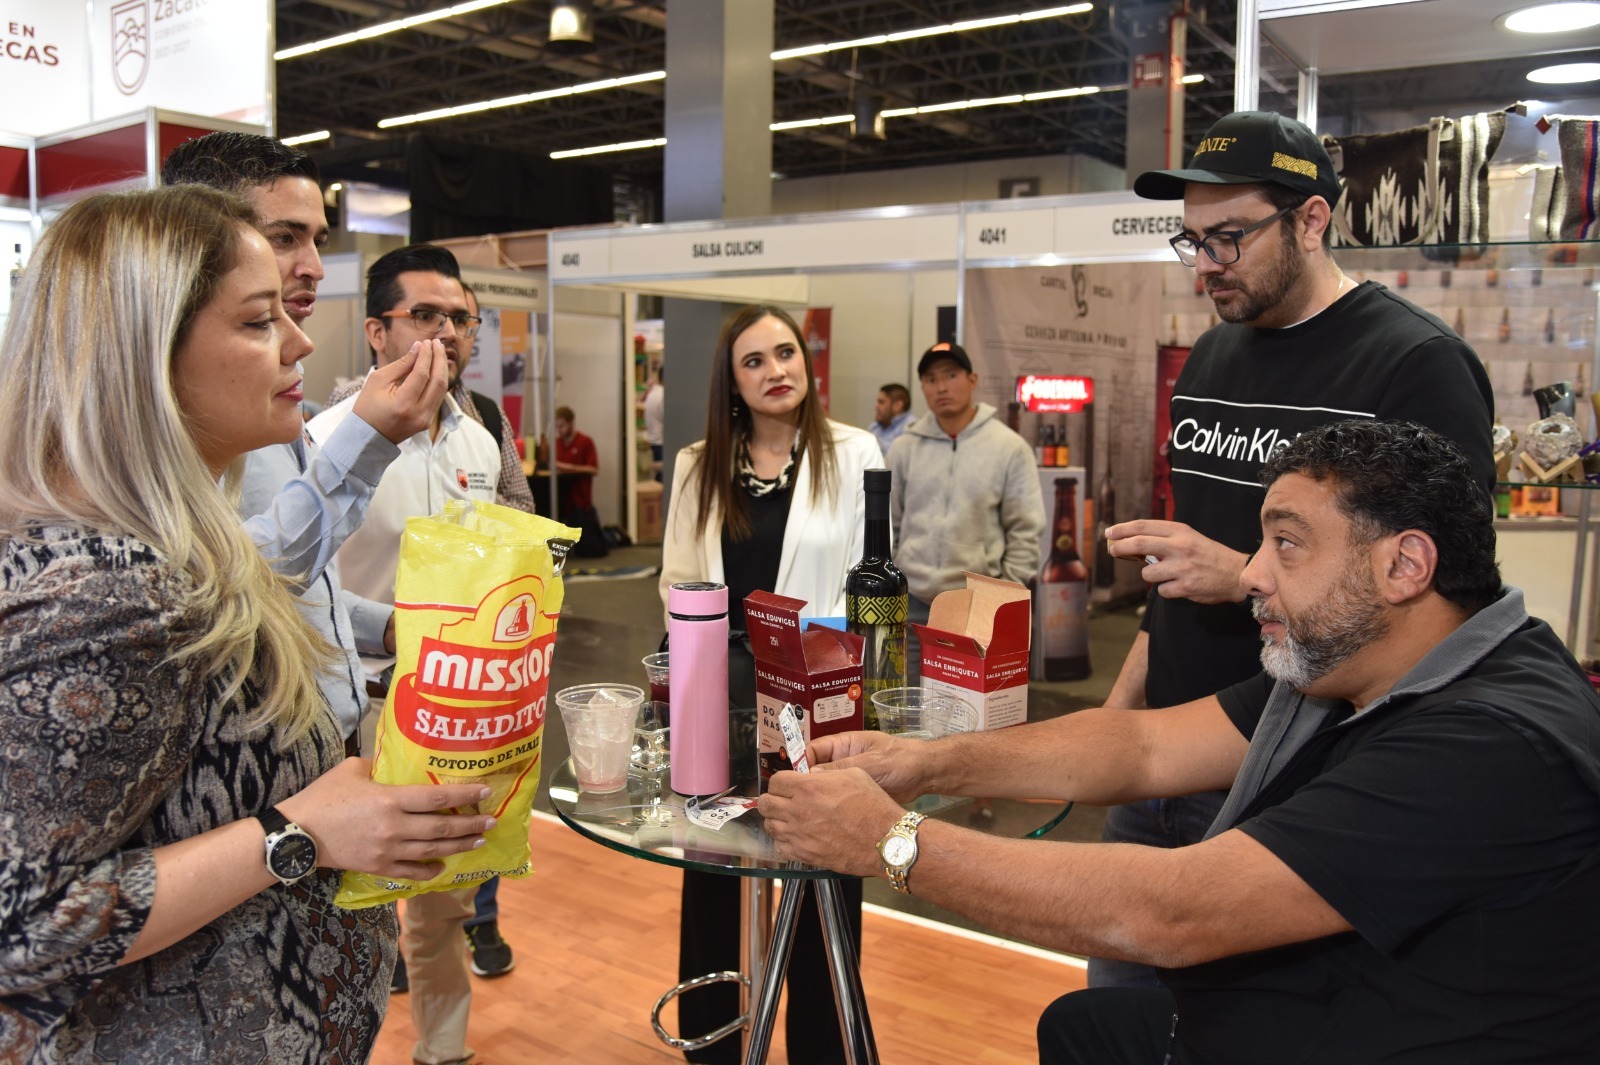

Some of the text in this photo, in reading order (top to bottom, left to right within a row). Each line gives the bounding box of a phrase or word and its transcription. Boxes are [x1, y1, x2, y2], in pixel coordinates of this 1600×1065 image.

[8, 21, 35, 38] EN
[1112, 216, 1184, 236] CERVECER
[979, 228, 1007, 244] 4041
[692, 240, 764, 258] SALSA CULICHI
[747, 608, 765, 619] SALSA
[766, 614, 796, 628] EDUVIGES
[422, 643, 555, 692] MISSION
[923, 658, 979, 679] SALSA ENRIQUETA
[986, 672, 1001, 680] SALSA
[1001, 666, 1027, 678] ENRIQUETA
[758, 670, 805, 692] SALSA EDUVIGES
[811, 675, 861, 690] SALSA EDUVIGES
[762, 705, 775, 716] DO
[763, 717, 781, 732] ÑAS
[428, 735, 541, 770] TOTOPOS DE MAÍZ
